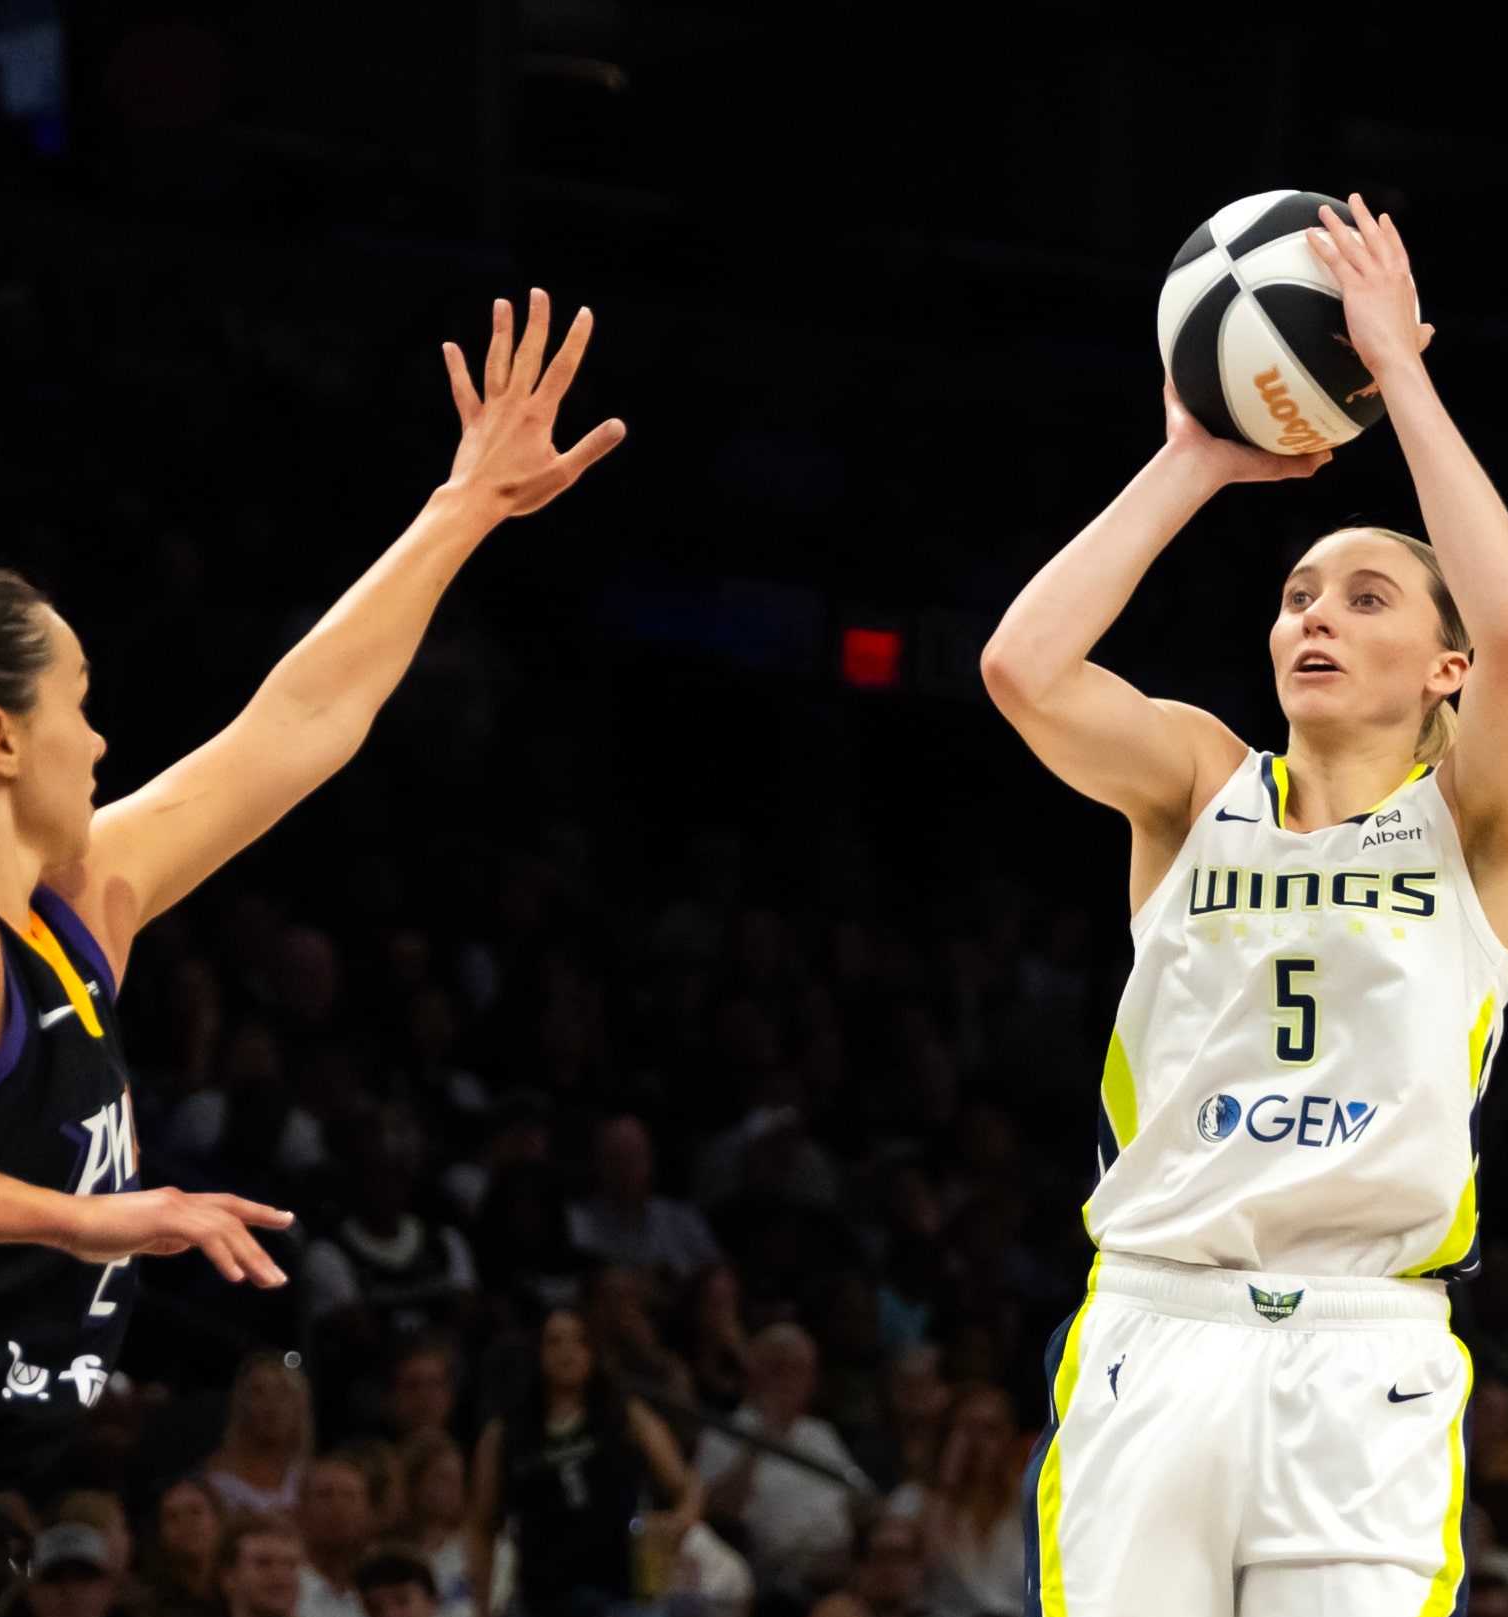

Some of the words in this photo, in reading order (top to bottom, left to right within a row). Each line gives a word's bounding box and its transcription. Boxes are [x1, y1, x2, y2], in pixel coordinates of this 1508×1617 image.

[1361, 826, 1423, 850] Albert
[1189, 867, 1437, 917] WINGS
[1275, 958, 1317, 1063] 5
[75, 1087, 140, 1197] PH
[1246, 1094, 1379, 1148] GEM
[1256, 1303, 1294, 1314] WINGS
